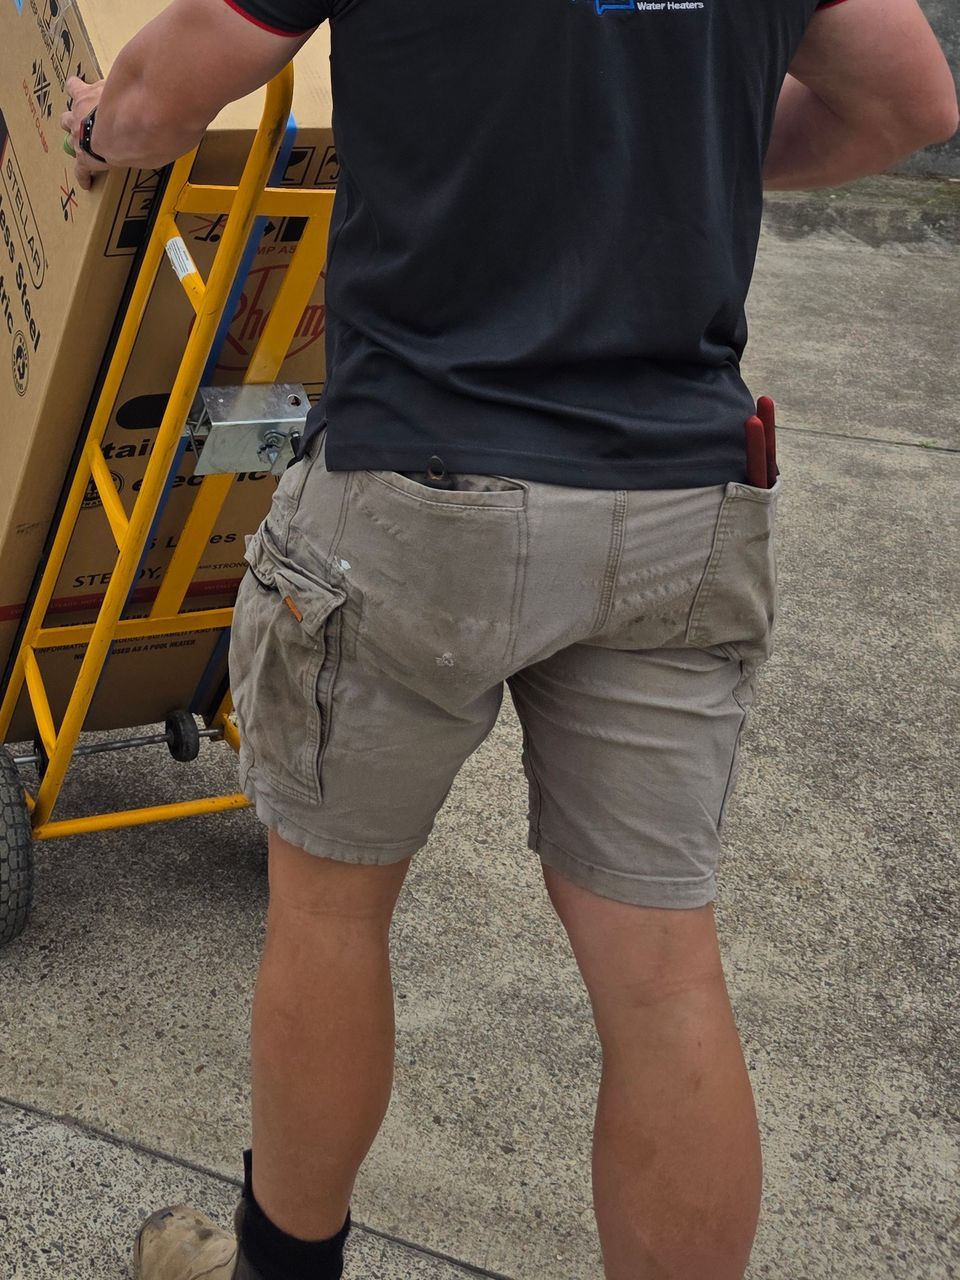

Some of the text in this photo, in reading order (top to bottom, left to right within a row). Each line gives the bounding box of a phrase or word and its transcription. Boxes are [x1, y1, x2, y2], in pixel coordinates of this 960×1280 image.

[637, 1, 704, 11] Water Heaters
[6, 158, 41, 274] STELLAR
[16, 261, 41, 353] Steel
